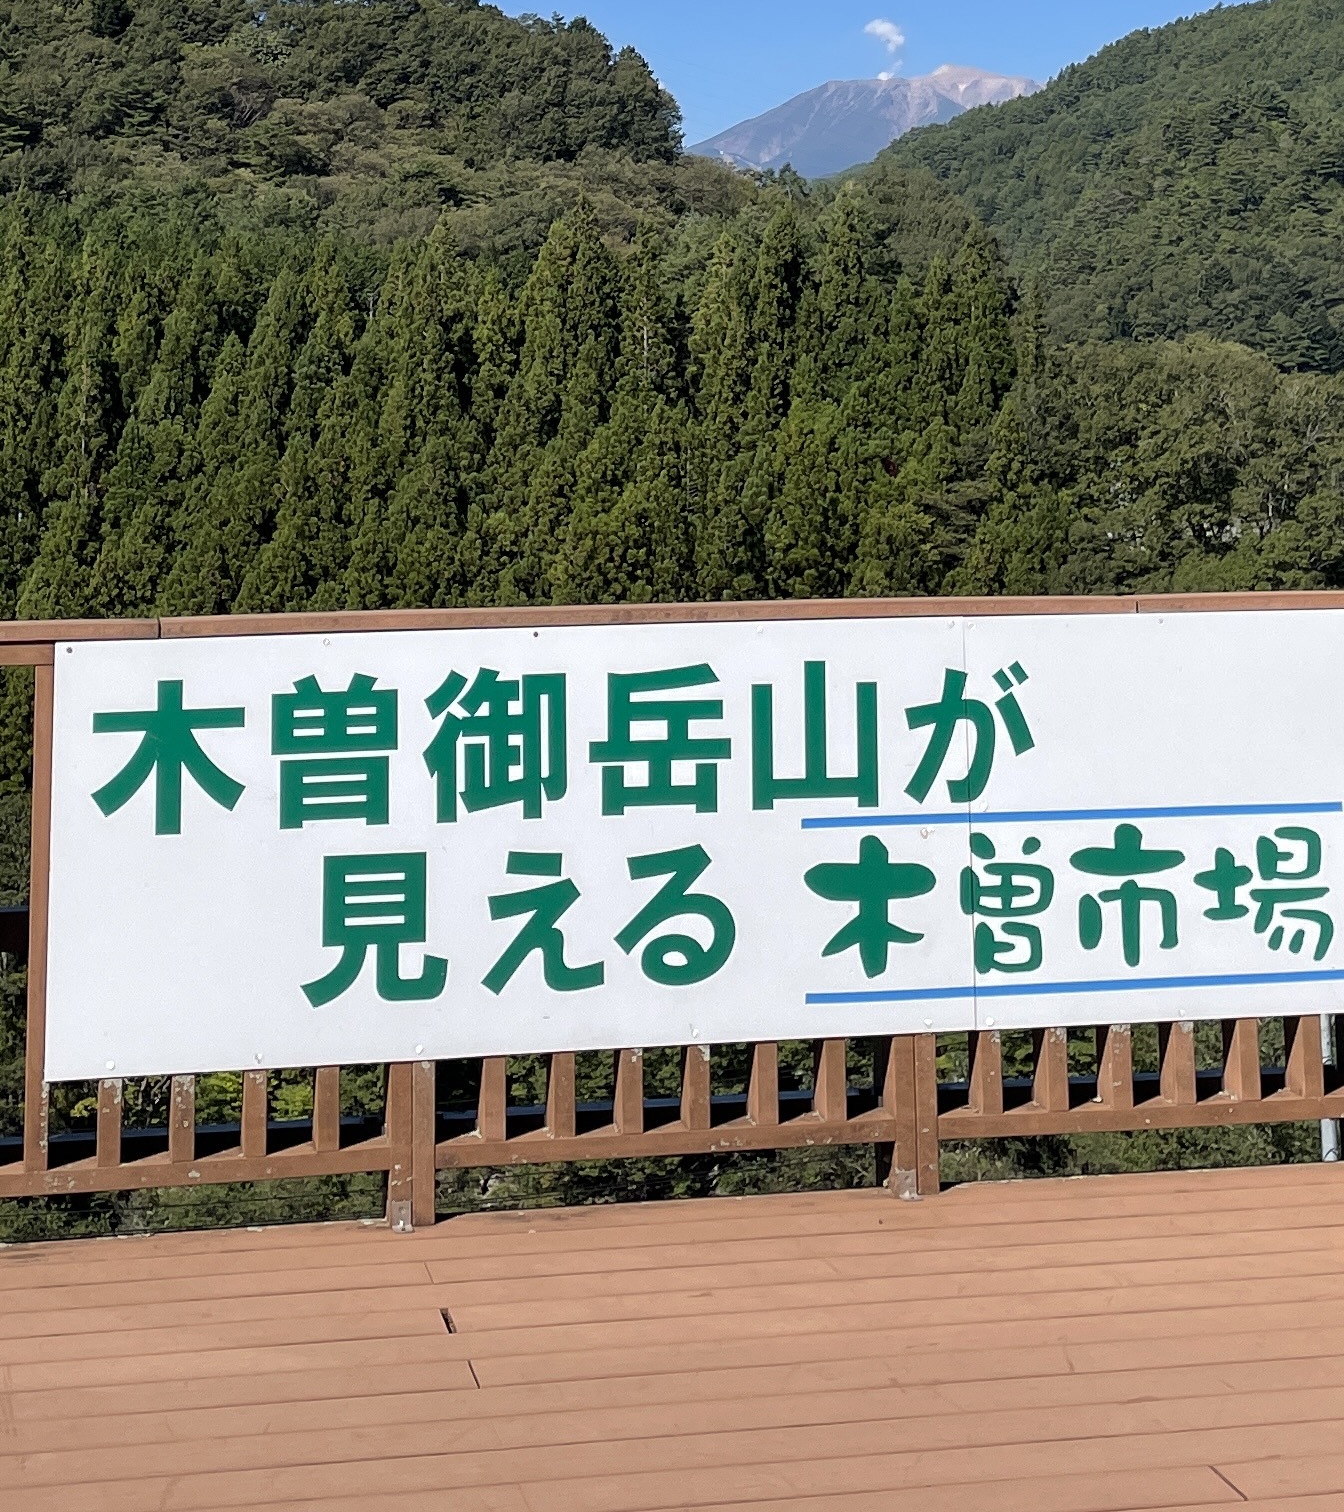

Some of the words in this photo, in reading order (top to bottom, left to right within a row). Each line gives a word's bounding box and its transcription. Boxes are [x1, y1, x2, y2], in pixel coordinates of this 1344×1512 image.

[91, 659, 1034, 835] 木曽御岳山が
[302, 844, 737, 1007] 見える
[803, 823, 1335, 978] 木曽市場
